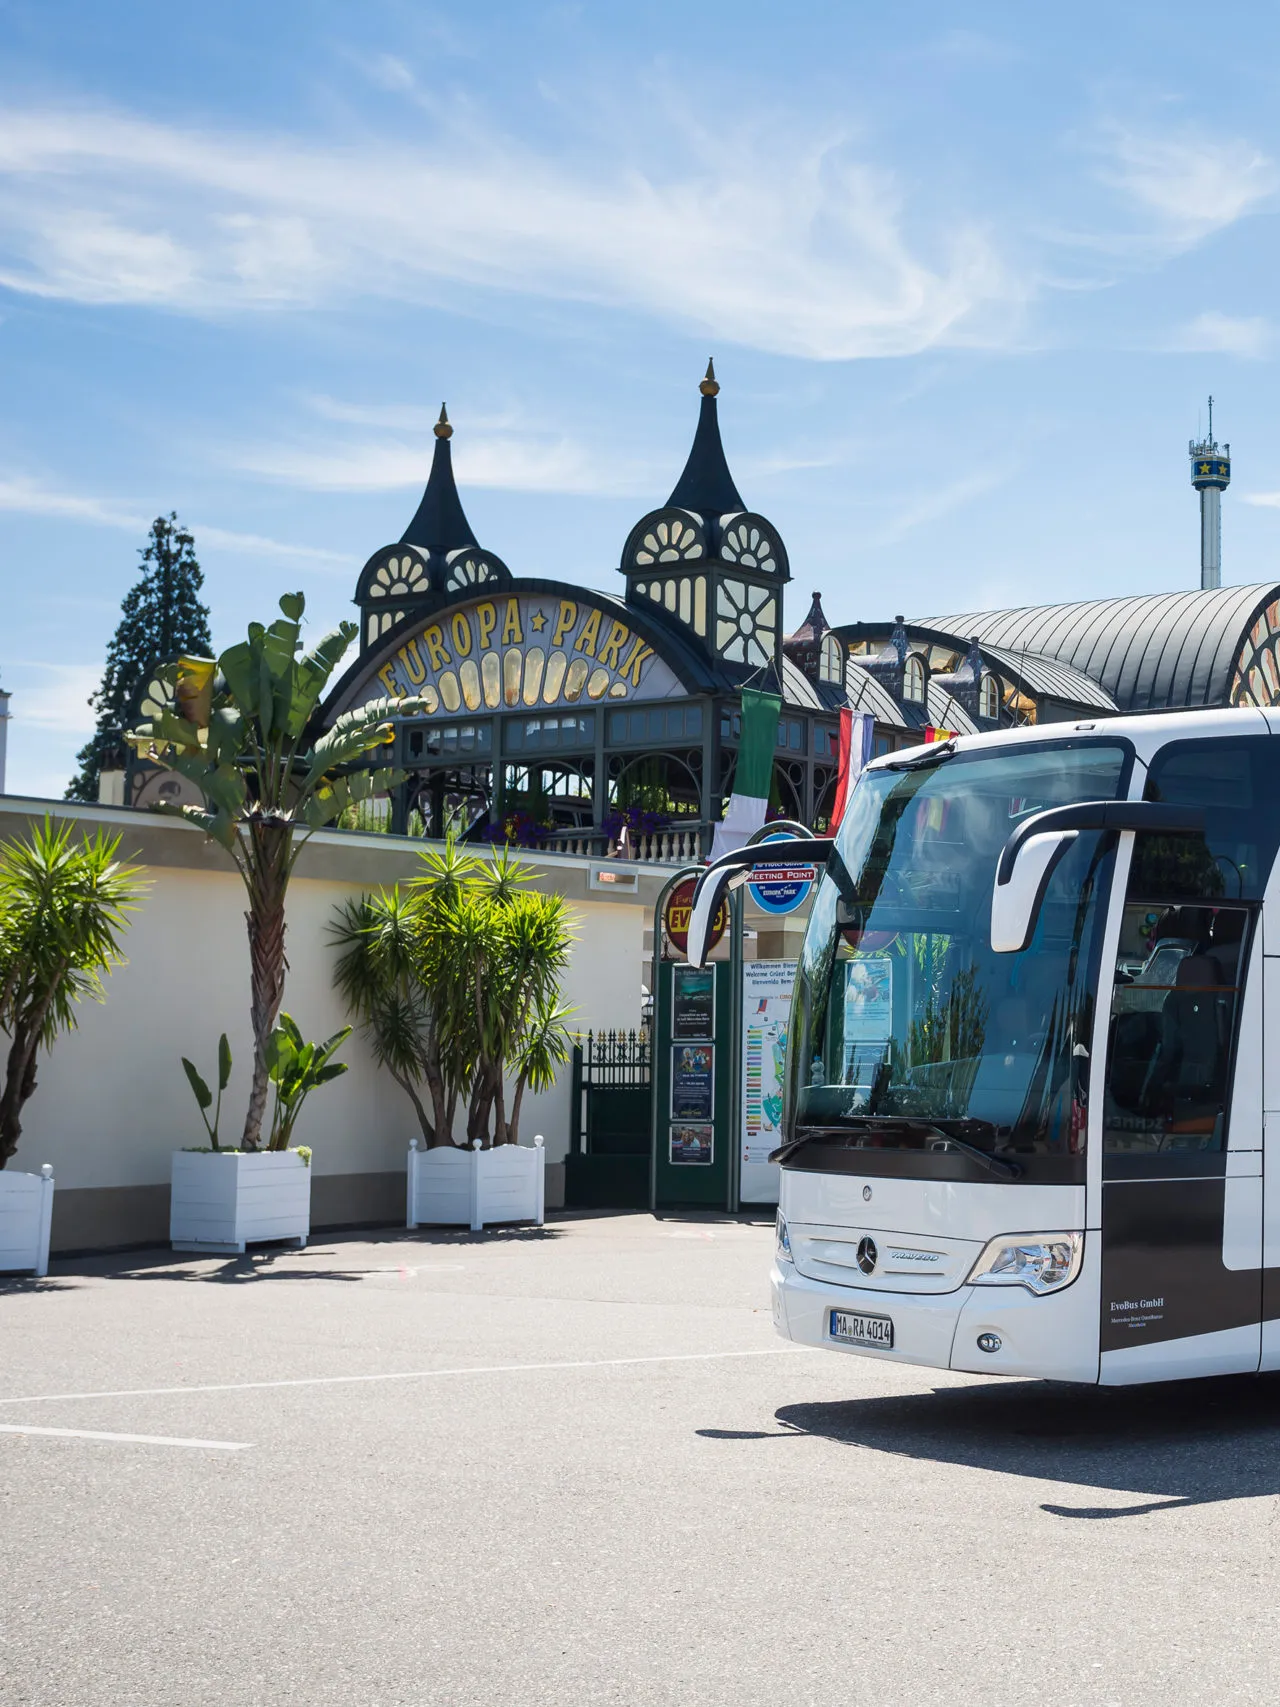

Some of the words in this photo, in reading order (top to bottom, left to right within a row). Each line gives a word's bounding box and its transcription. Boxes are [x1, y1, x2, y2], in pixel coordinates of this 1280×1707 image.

[378, 598, 524, 698] EUROPA
[552, 600, 655, 687] PARK
[787, 871, 813, 879] POINT
[1110, 1301, 1138, 1311] EvoBus
[1140, 1298, 1164, 1308] GmbH
[853, 1318, 865, 1337] RA
[866, 1320, 890, 1341] 4014
